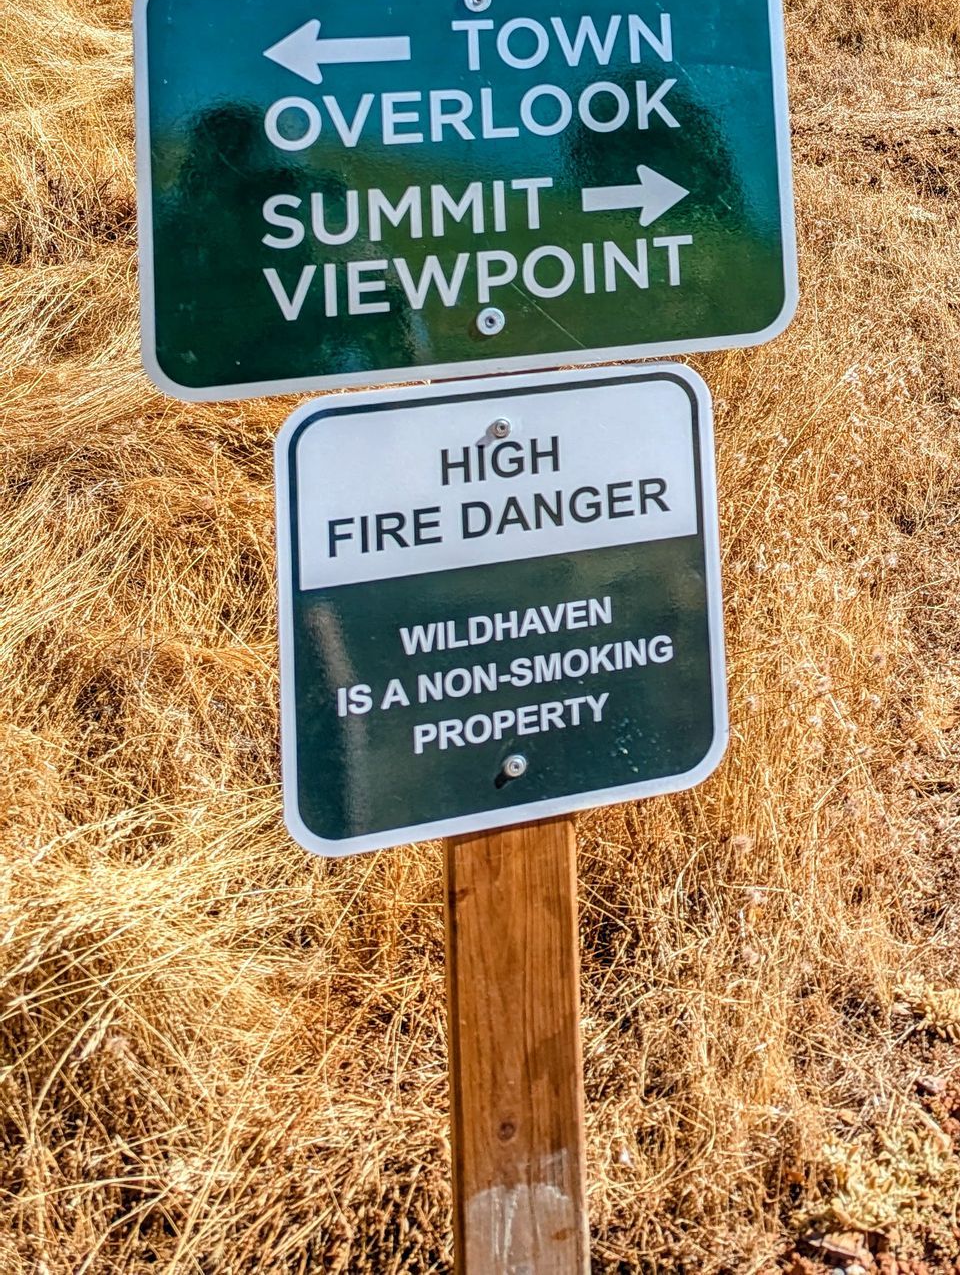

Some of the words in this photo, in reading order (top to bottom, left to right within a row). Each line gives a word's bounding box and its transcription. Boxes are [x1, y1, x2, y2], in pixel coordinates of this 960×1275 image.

[452, 13, 673, 71] TOWN
[264, 79, 680, 151] OVERLOOK
[262, 178, 553, 249] SUMMIT
[264, 235, 693, 321] VIEWPOINT
[440, 435, 560, 486] HIGH
[327, 506, 443, 559] FIRE
[461, 477, 671, 540] DANGER
[400, 596, 613, 656] WILDHAVEN
[336, 685, 373, 718] IS
[380, 677, 411, 711] A
[418, 634, 674, 704] NON-SMOKING
[413, 692, 610, 755] PROPERTY
